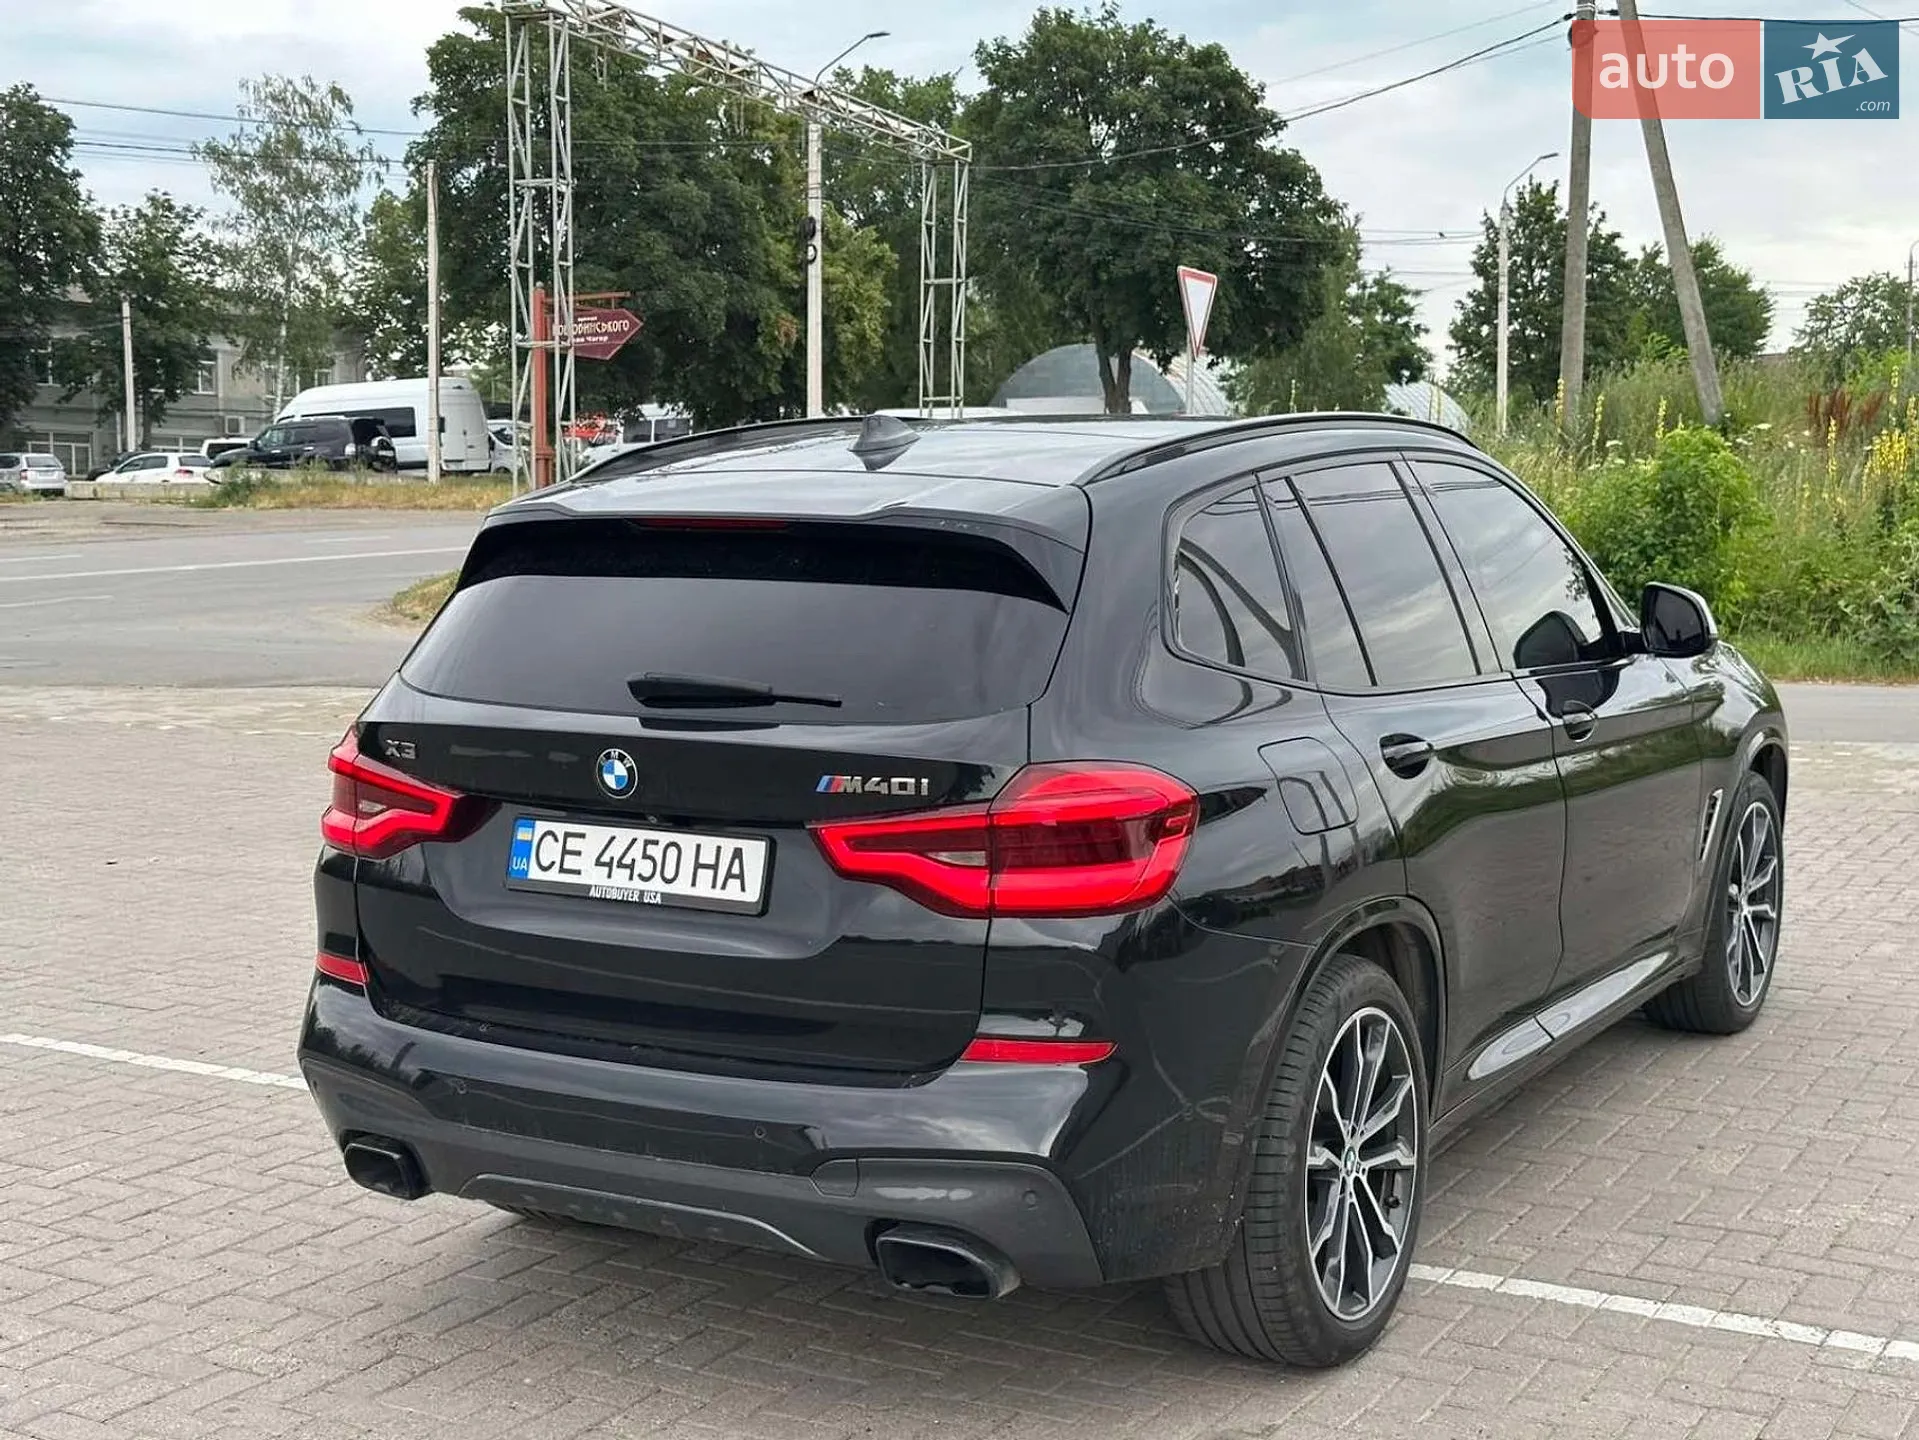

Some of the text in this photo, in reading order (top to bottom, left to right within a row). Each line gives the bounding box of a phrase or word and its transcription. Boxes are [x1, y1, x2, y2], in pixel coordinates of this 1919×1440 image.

[385, 739, 416, 759] X3
[600, 750, 633, 768] BMW
[512, 857, 528, 871] UA
[535, 830, 746, 892] CE 4450 HA
[589, 884, 662, 904] AUTOBUYER USA
